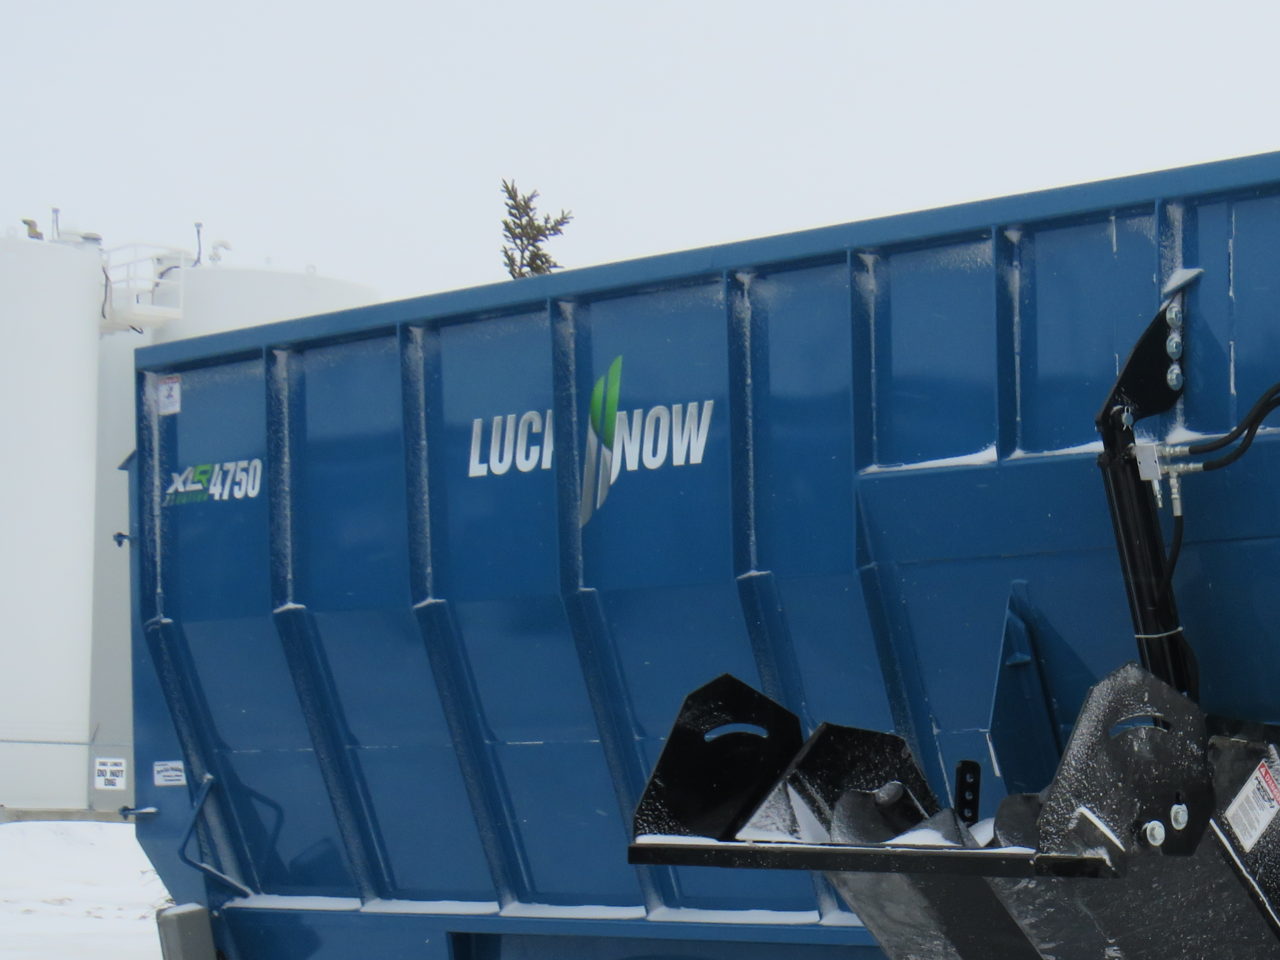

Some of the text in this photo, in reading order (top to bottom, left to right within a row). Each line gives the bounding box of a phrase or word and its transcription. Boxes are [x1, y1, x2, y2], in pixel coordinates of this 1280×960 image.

[209, 458, 263, 501] 4750
[98, 769, 124, 778] DO NOT
